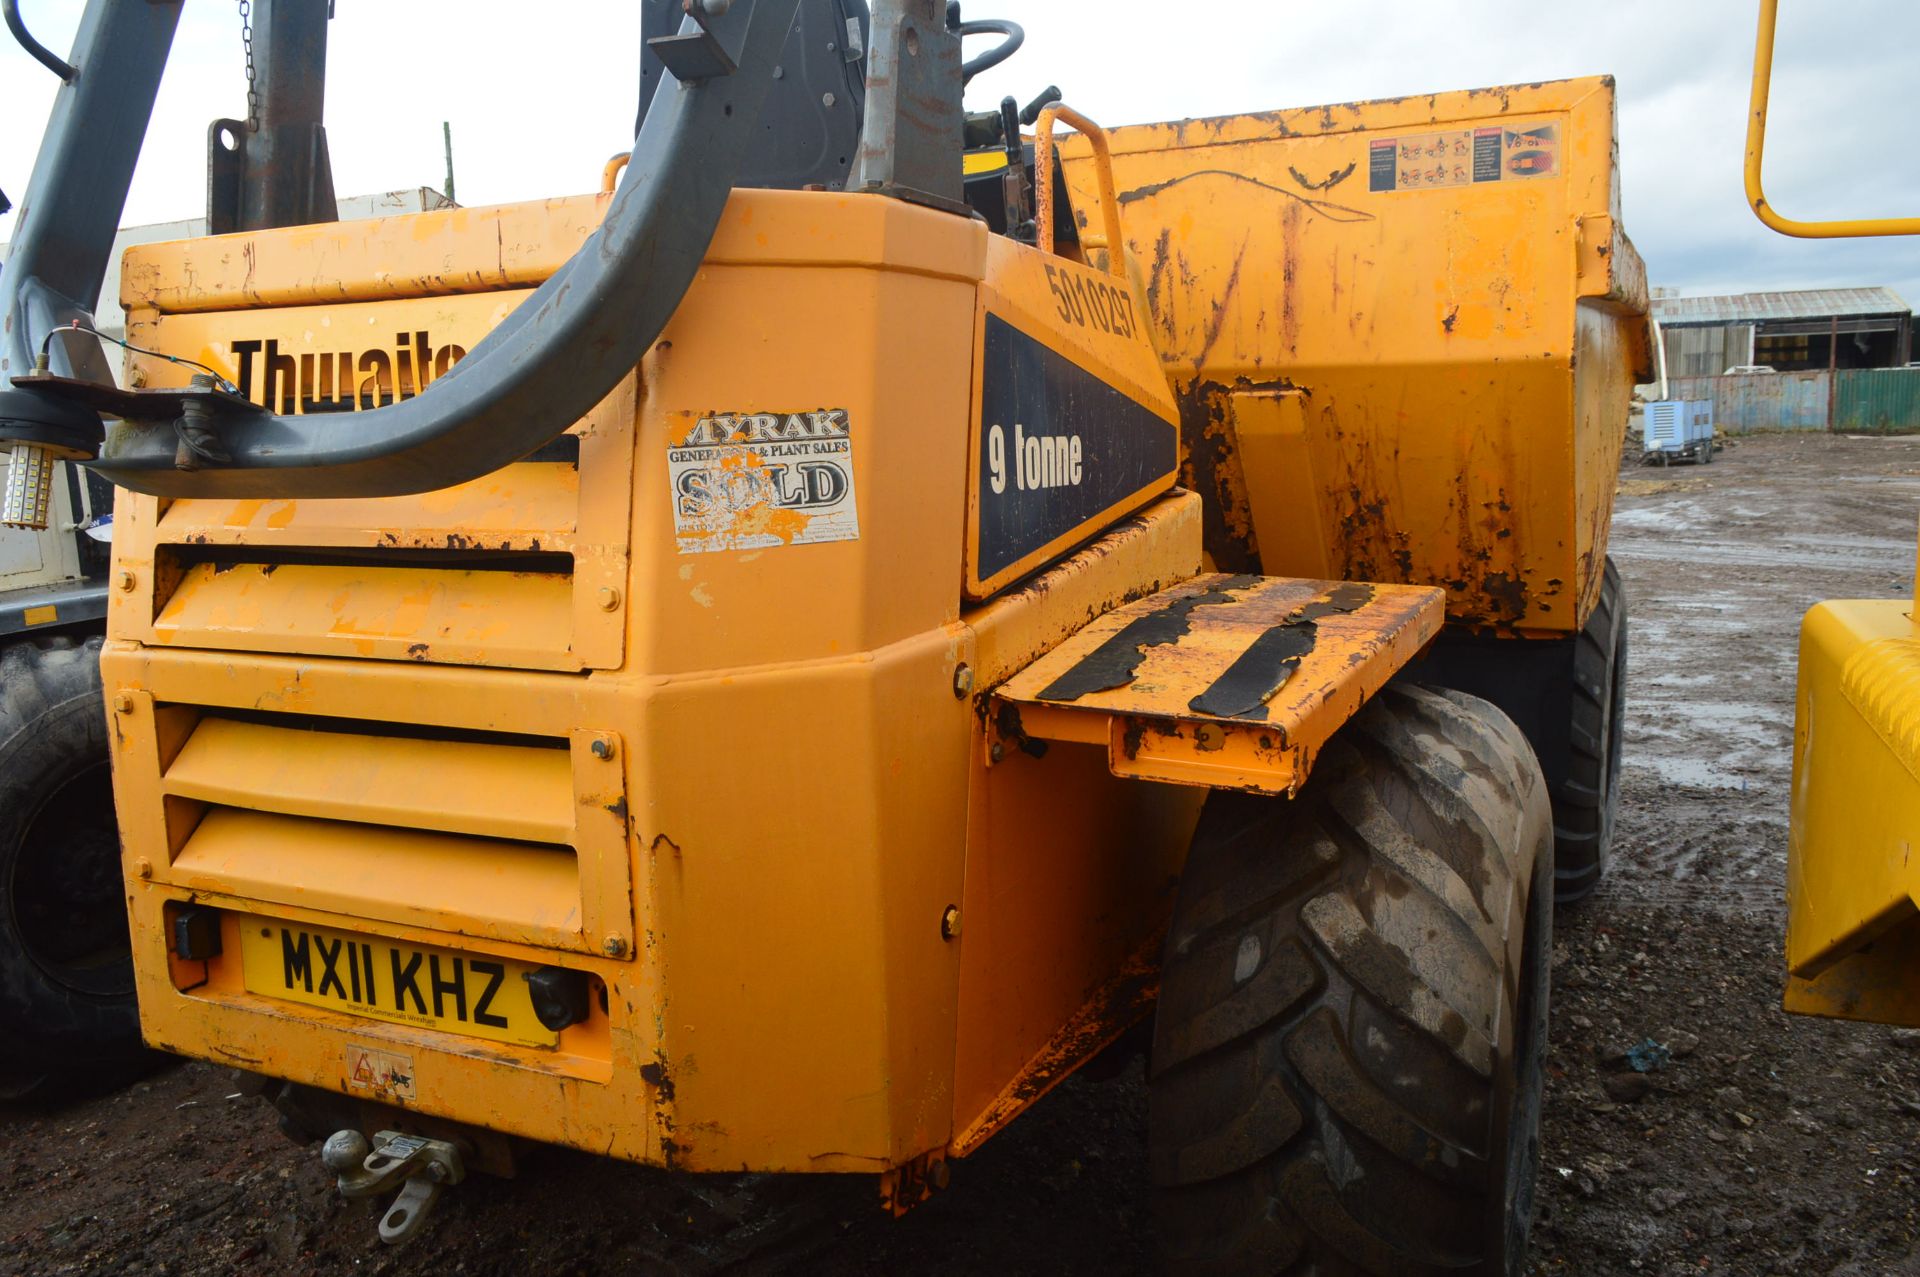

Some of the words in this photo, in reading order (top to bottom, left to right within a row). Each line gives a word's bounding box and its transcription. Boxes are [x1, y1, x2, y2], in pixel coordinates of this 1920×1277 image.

[1044, 263, 1138, 340] 5010297
[669, 448, 756, 464] GENERAS
[759, 447, 769, 457] &
[770, 444, 810, 457] PLANT
[813, 441, 849, 455] SALES
[989, 424, 1006, 494] 9
[1015, 424, 1082, 490] tonne
[281, 928, 376, 1006] MX11
[390, 948, 508, 1029] KHZ
